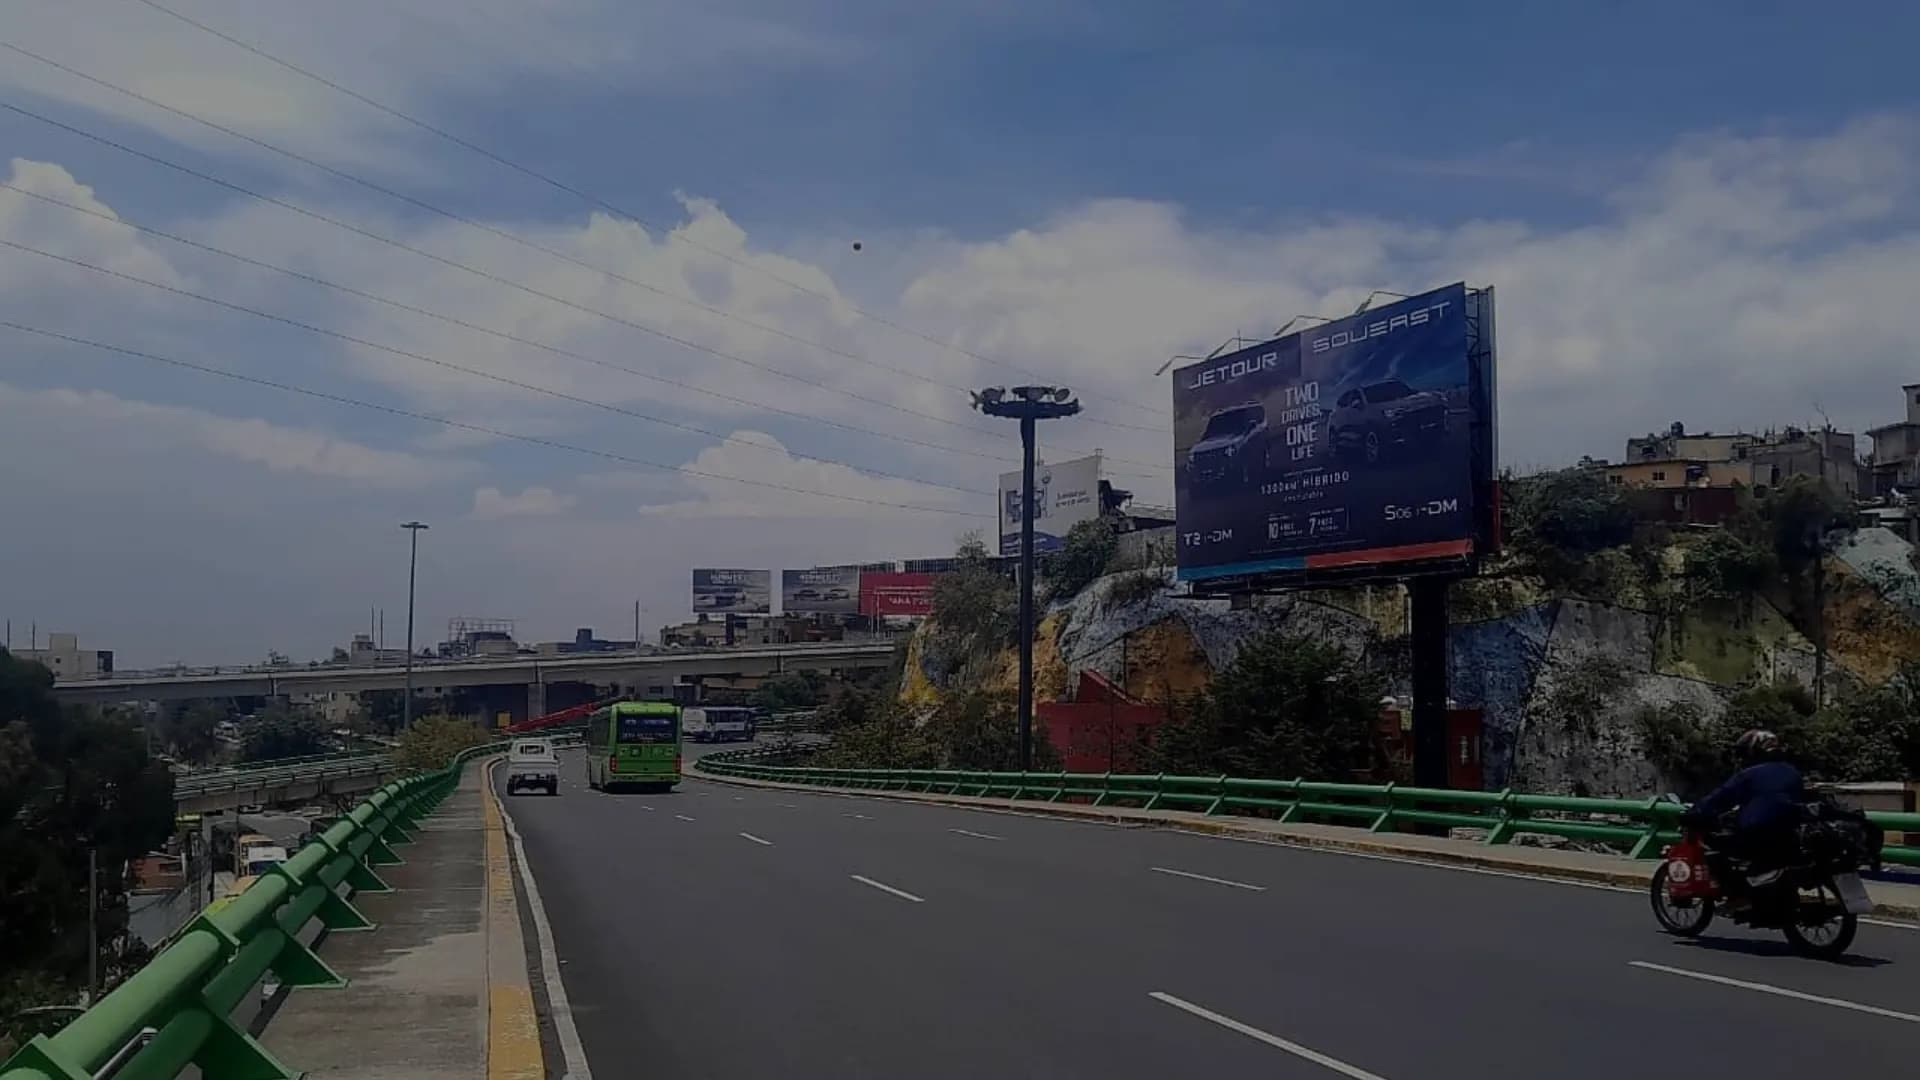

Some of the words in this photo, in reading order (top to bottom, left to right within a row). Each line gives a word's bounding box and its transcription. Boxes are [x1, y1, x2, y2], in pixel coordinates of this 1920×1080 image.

[1312, 301, 1451, 353] SOUEAST
[1188, 352, 1278, 390] JETOUR
[1285, 381, 1319, 407] TWO
[1281, 403, 1320, 424] DRIVES
[1286, 422, 1319, 446] ONE
[1291, 444, 1314, 461] LIFE
[1183, 531, 1201, 546] T2
[1268, 522, 1279, 539] 10
